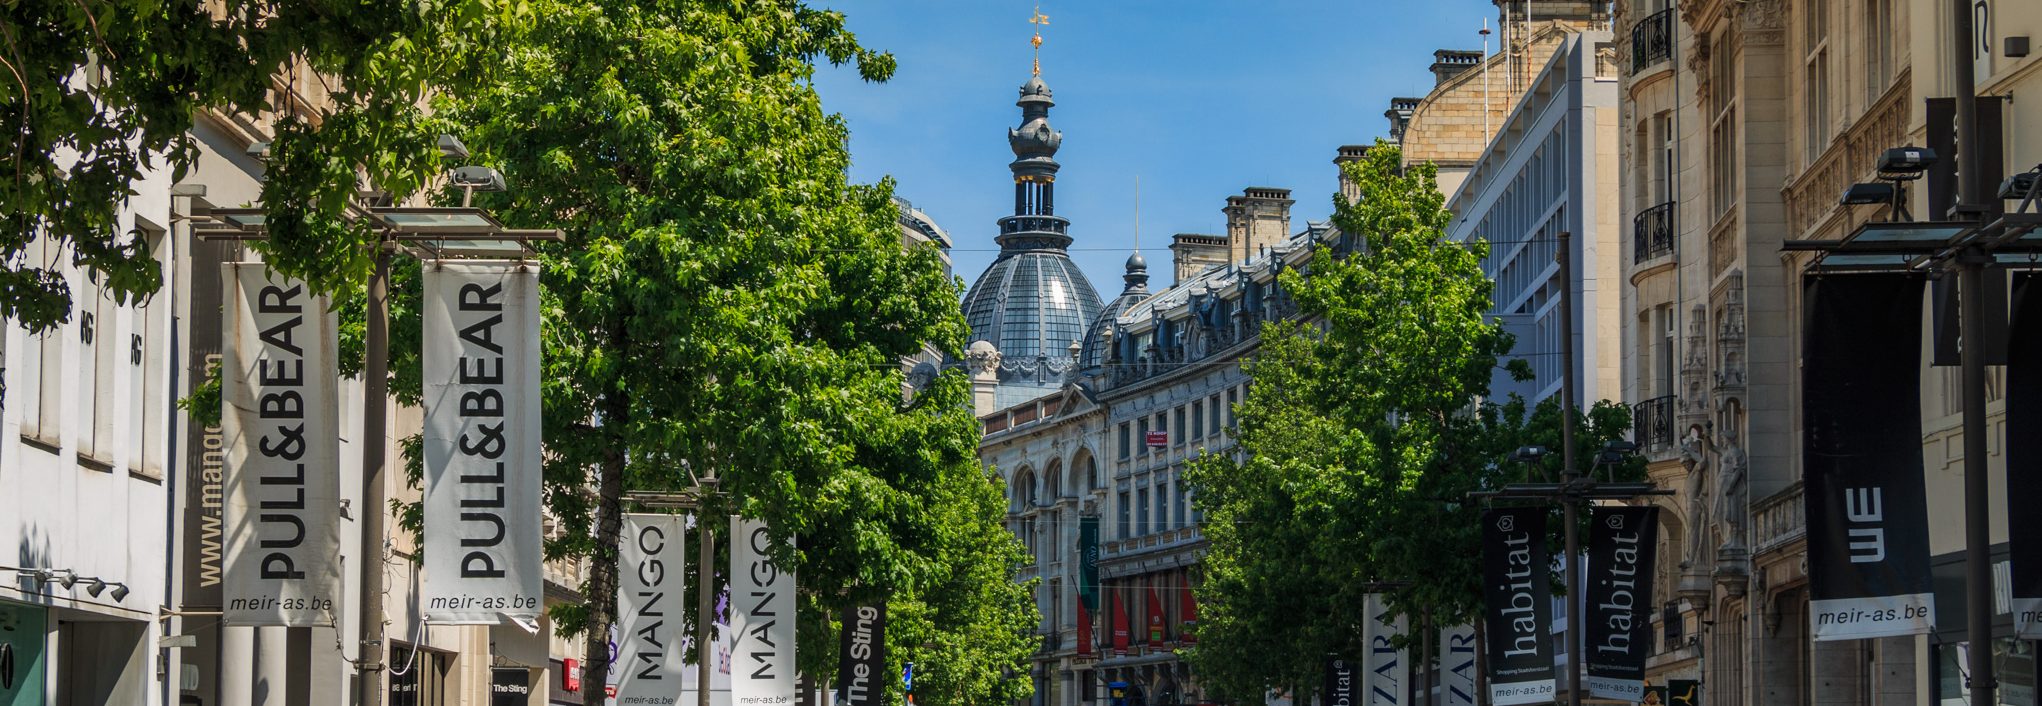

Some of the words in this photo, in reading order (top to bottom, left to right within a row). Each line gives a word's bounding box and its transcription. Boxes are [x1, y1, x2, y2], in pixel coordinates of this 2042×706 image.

[258, 284, 305, 580] PULL&BEAR
[459, 282, 505, 578] PULL&BEAR
[1846, 487, 1885, 563] WE
[229, 595, 332, 612] meir-as.be
[430, 594, 537, 610] meir-as.be
[637, 525, 665, 680] MANGO
[750, 527, 776, 679] MANGO
[1500, 532, 1537, 659] habitat
[1598, 532, 1639, 655] habitat
[1818, 604, 1928, 625] meir-as.be
[850, 606, 878, 660] Sting
[494, 684, 507, 693] The
[508, 684, 528, 694] Sting
[624, 695, 674, 705] meir-as.be
[740, 695, 787, 705] meir-as.be
[847, 664, 870, 706] The
[1495, 685, 1552, 697] meir-as.be
[1590, 680, 1640, 694] meir-as.be
